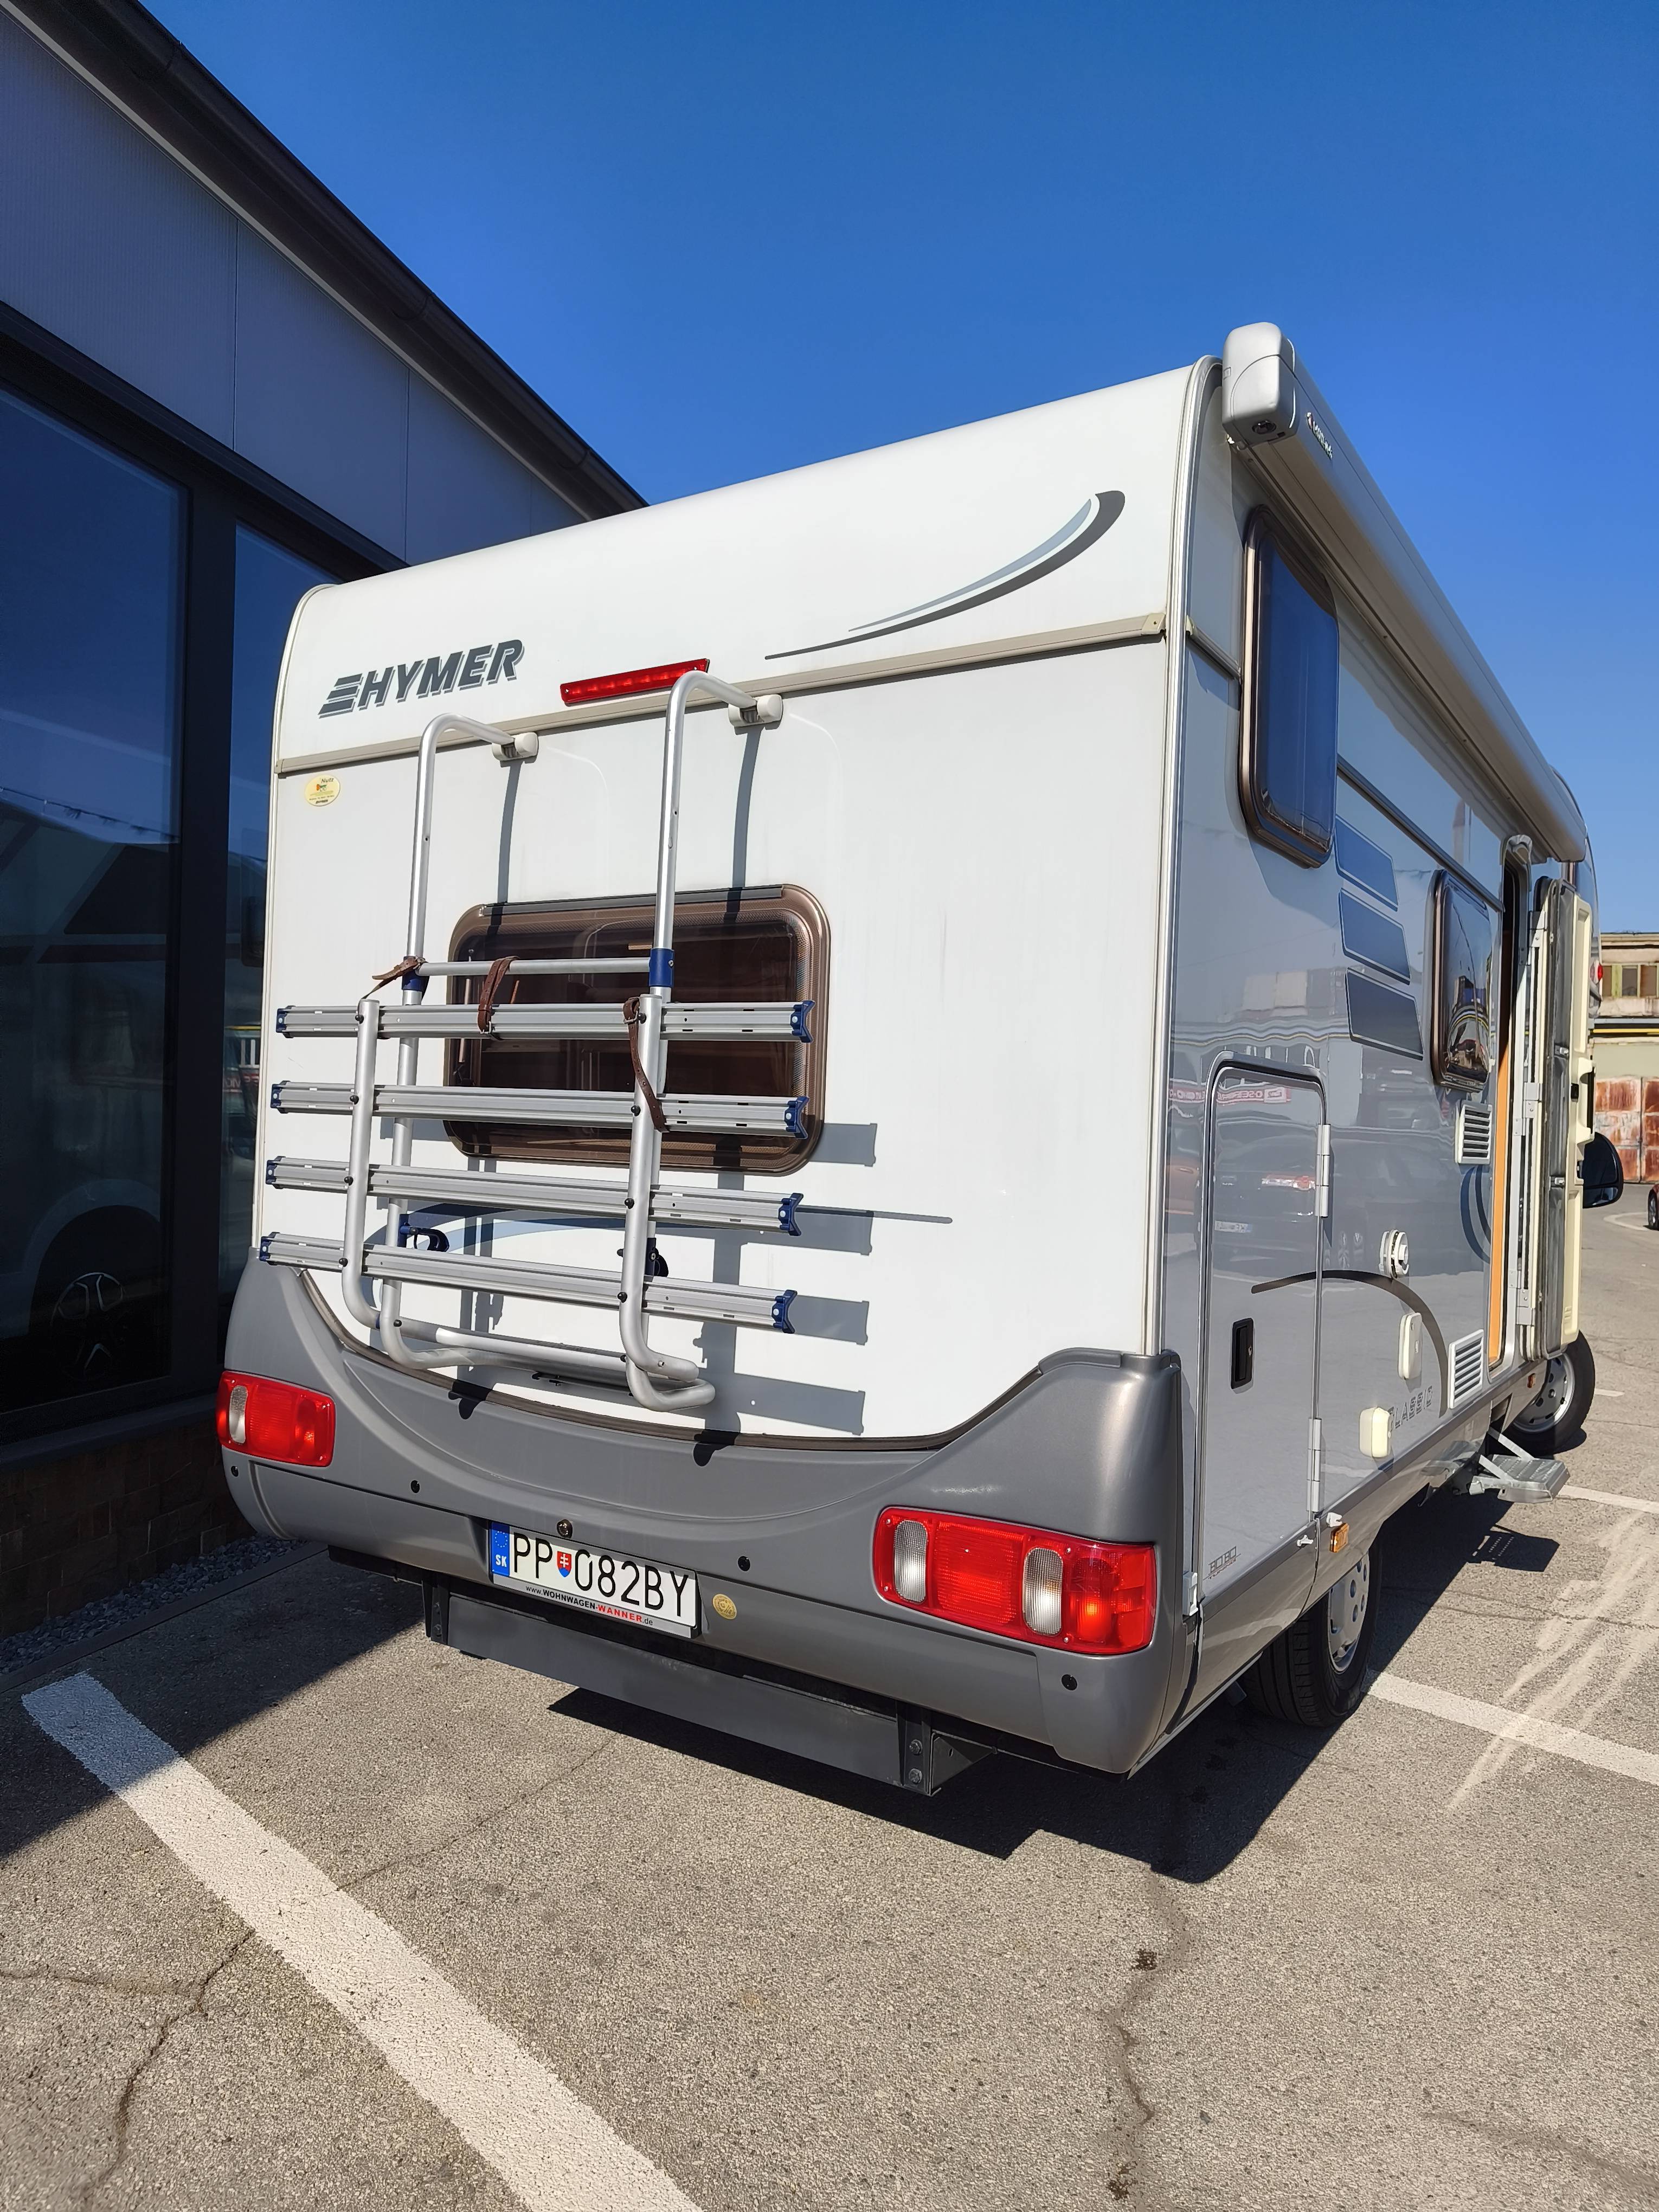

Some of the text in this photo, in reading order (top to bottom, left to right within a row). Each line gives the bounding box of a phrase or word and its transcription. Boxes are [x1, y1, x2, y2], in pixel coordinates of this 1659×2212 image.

[357, 639, 525, 711] HYMER
[496, 1554, 507, 1567] SK
[513, 1532, 553, 1579] PP
[575, 1548, 689, 1617] 082BY
[525, 1585, 653, 1625] www.WOHNWAGEN-WANNER.de
